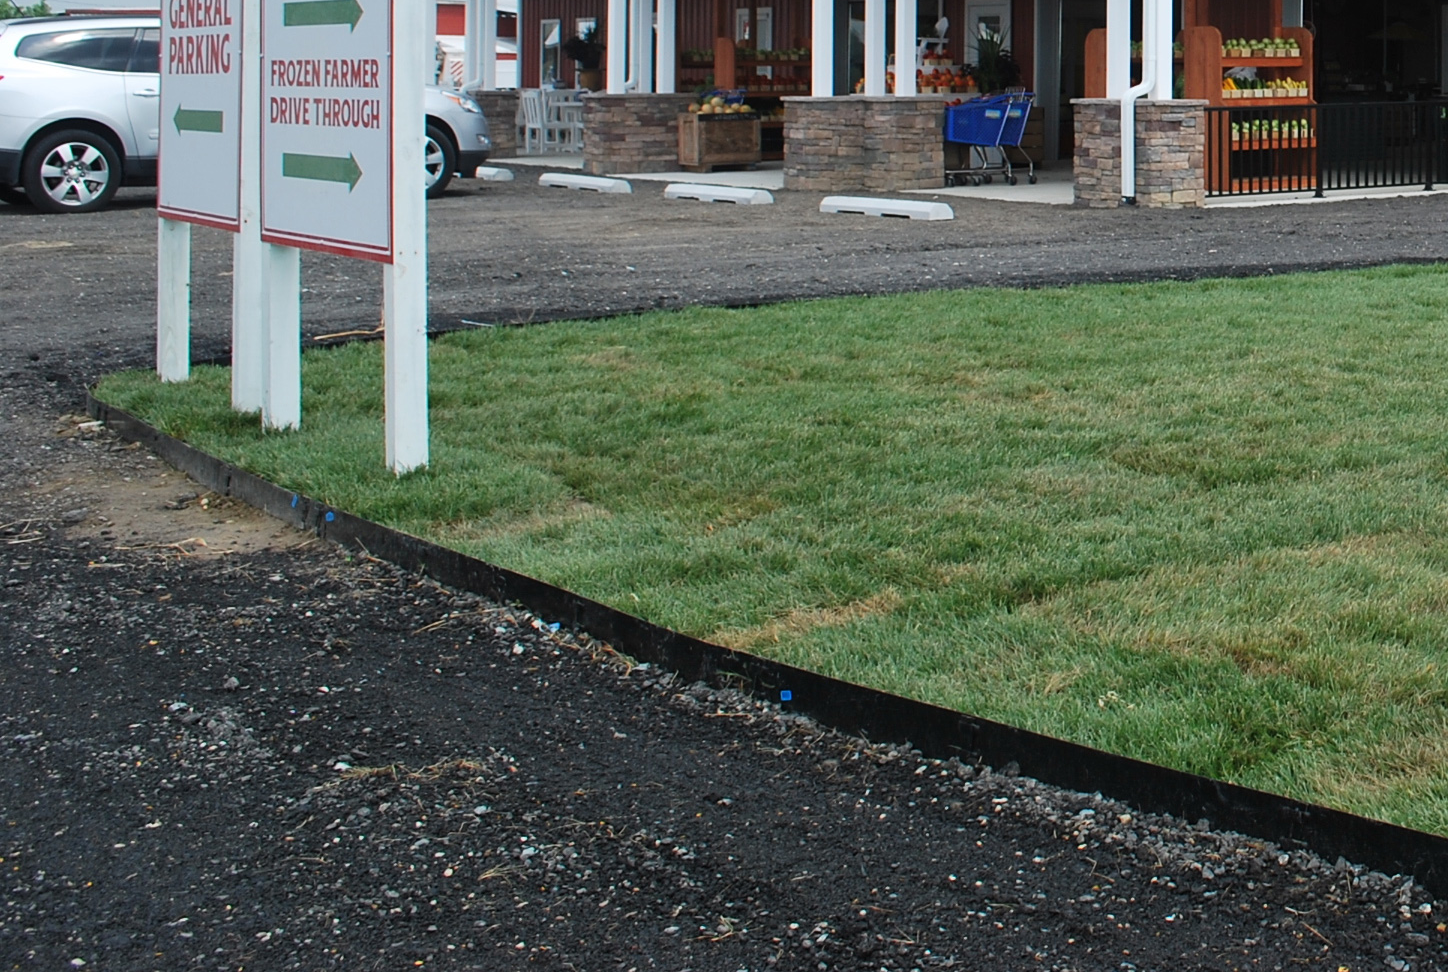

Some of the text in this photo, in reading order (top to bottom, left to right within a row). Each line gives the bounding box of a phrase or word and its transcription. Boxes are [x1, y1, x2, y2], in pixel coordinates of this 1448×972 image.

[168, 34, 231, 75] PARKING
[270, 58, 379, 88] FROZEN FARMER
[270, 97, 380, 129] DRIVE THROUGH
